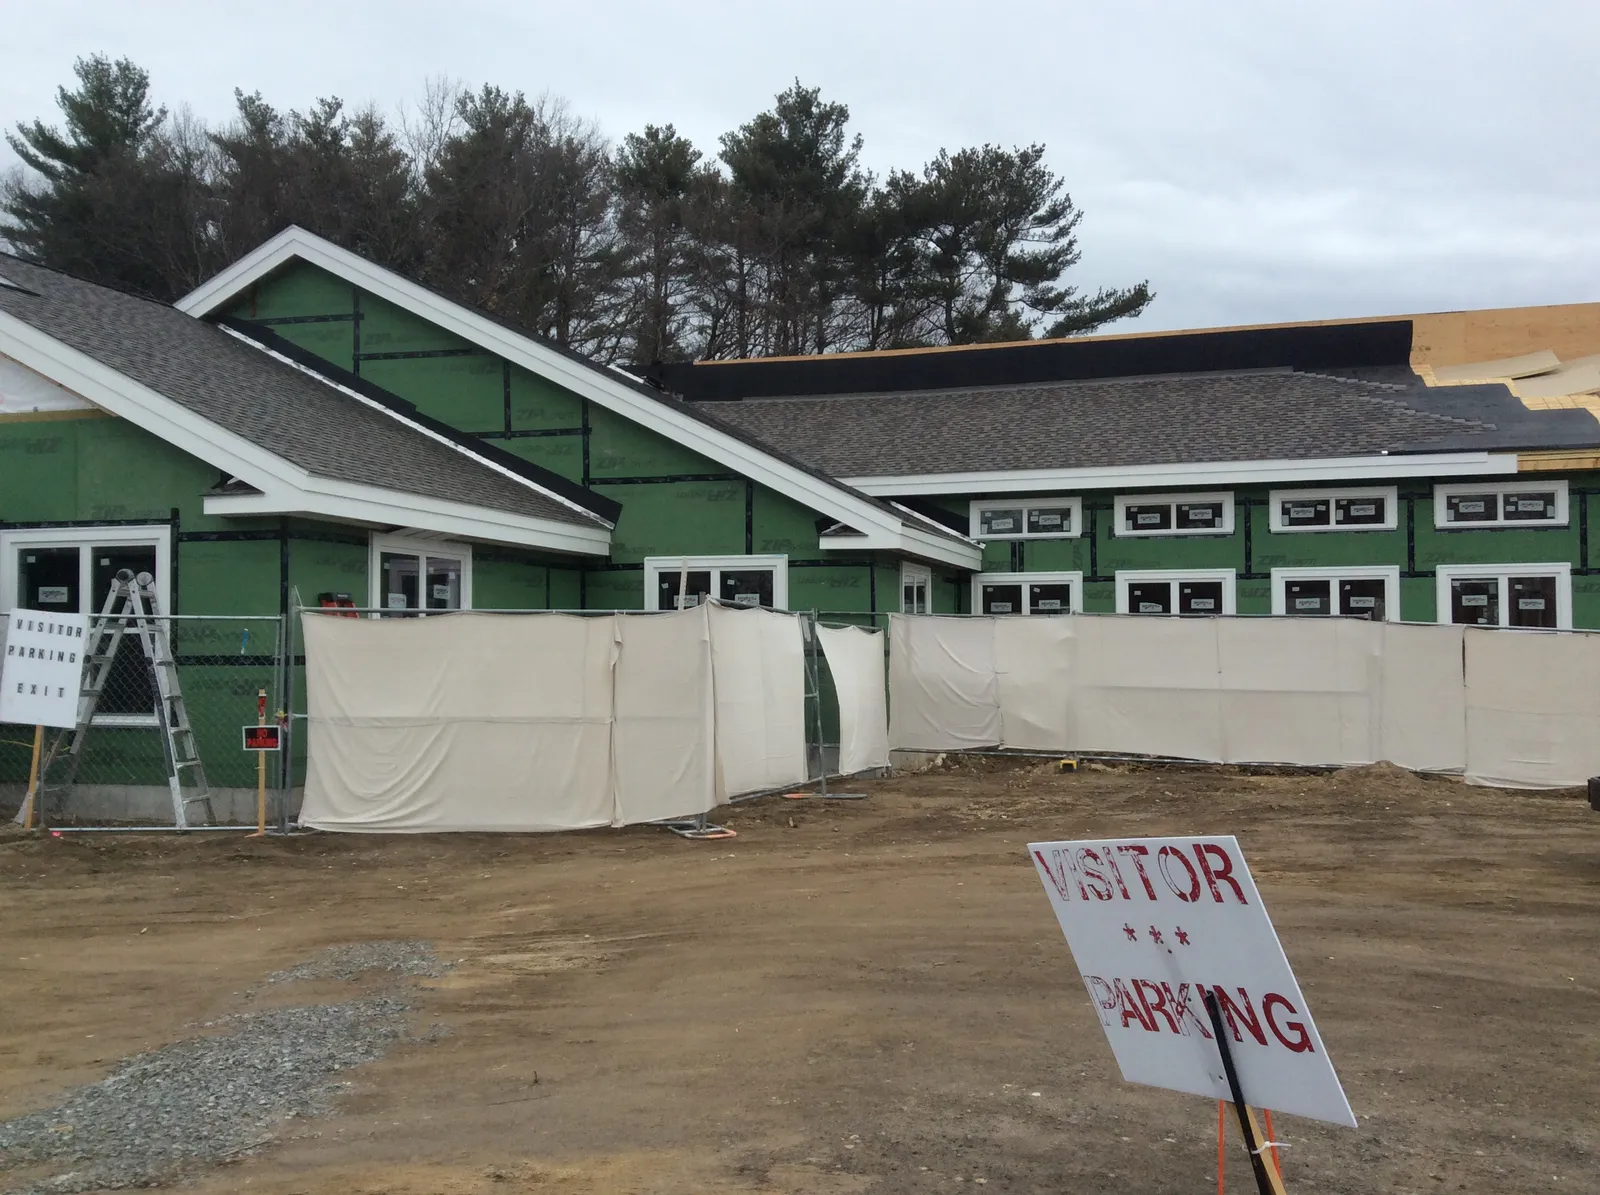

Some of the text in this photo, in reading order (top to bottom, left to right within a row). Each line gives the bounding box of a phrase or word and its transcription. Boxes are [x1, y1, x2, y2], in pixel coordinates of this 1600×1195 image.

[17, 619, 83, 637] VISITOR
[8, 645, 76, 663] PARKING
[17, 683, 65, 697] EXIT
[1034, 844, 1248, 905] VISITOR
